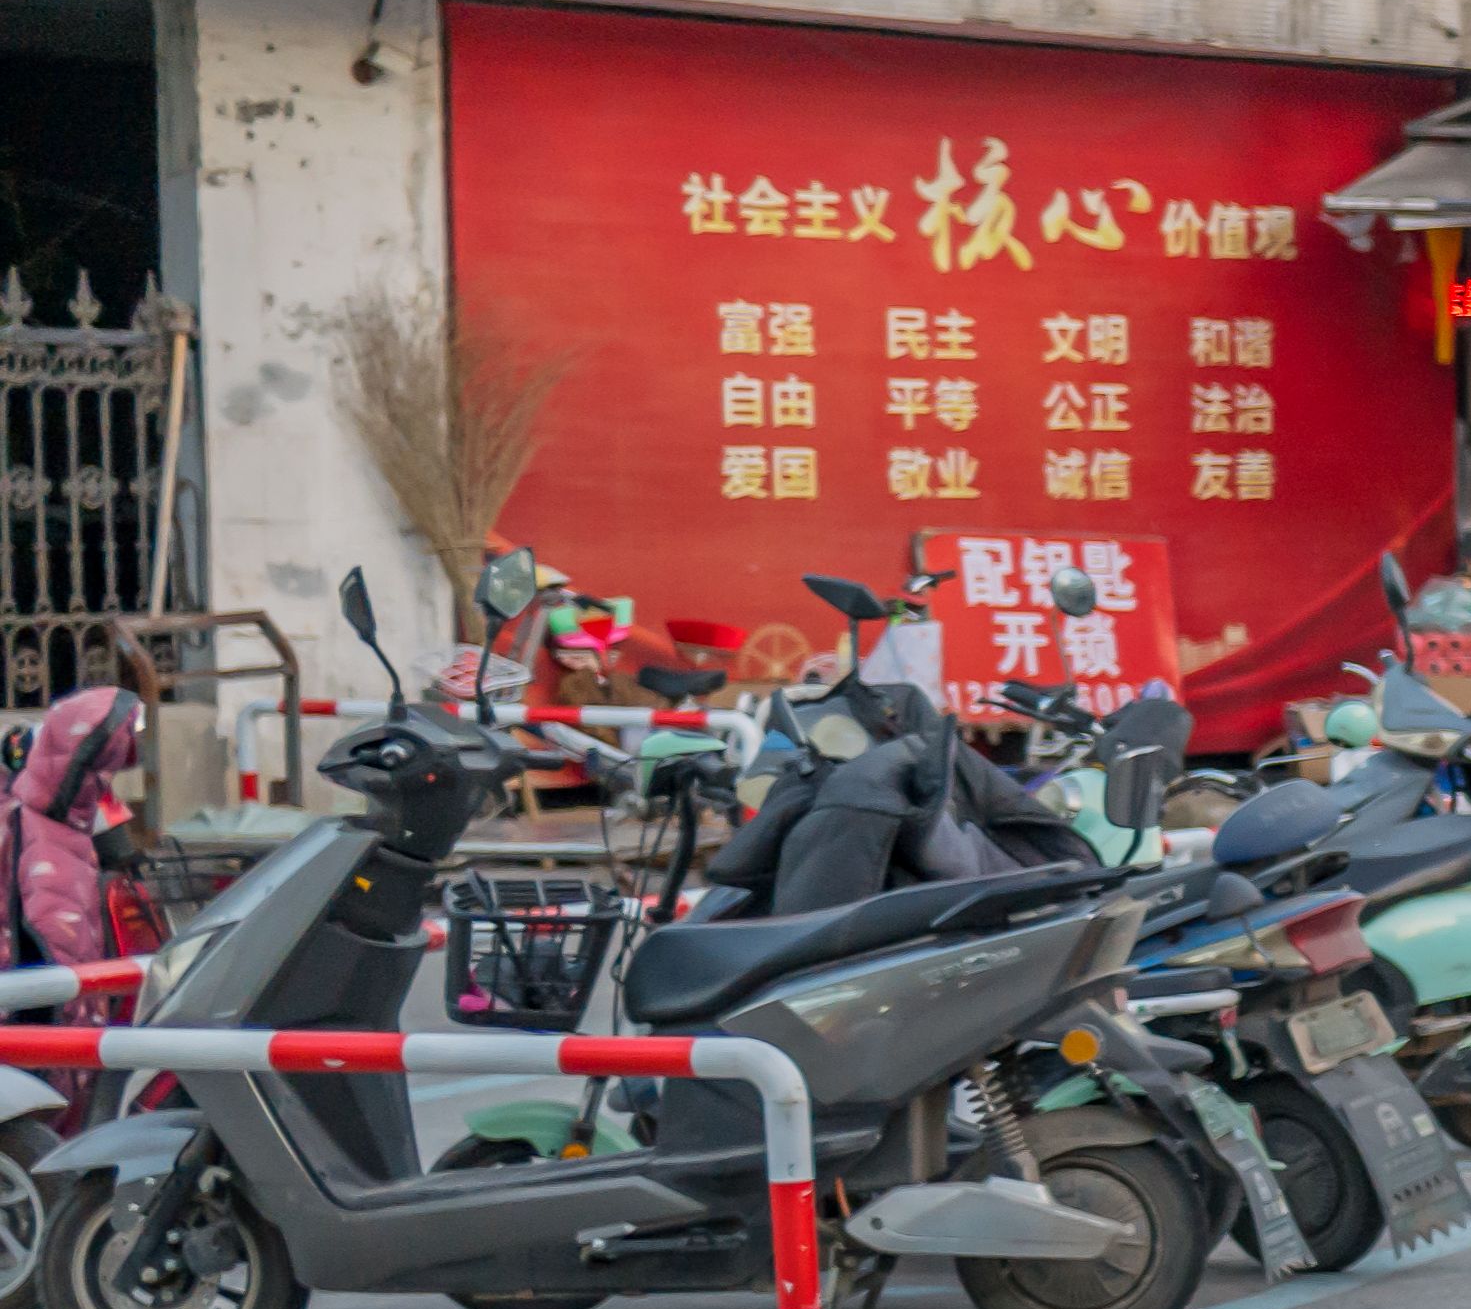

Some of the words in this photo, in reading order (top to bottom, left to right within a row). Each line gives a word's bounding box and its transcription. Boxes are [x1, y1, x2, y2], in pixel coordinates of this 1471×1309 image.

[717, 301, 818, 359] 富强
[886, 307, 977, 361] 民主
[1042, 312, 1131, 365] 文明
[1190, 317, 1275, 369] 和谐
[720, 375, 817, 430] 自由
[886, 378, 979, 432] 平等
[1043, 382, 1132, 433] 公正
[1191, 384, 1277, 435] 法治
[720, 446, 819, 501] 爱国
[886, 448, 980, 501] 敬业
[1044, 449, 1133, 502] 诚信
[1191, 451, 1276, 502] 友善
[992, 611, 1122, 678] 开锁
